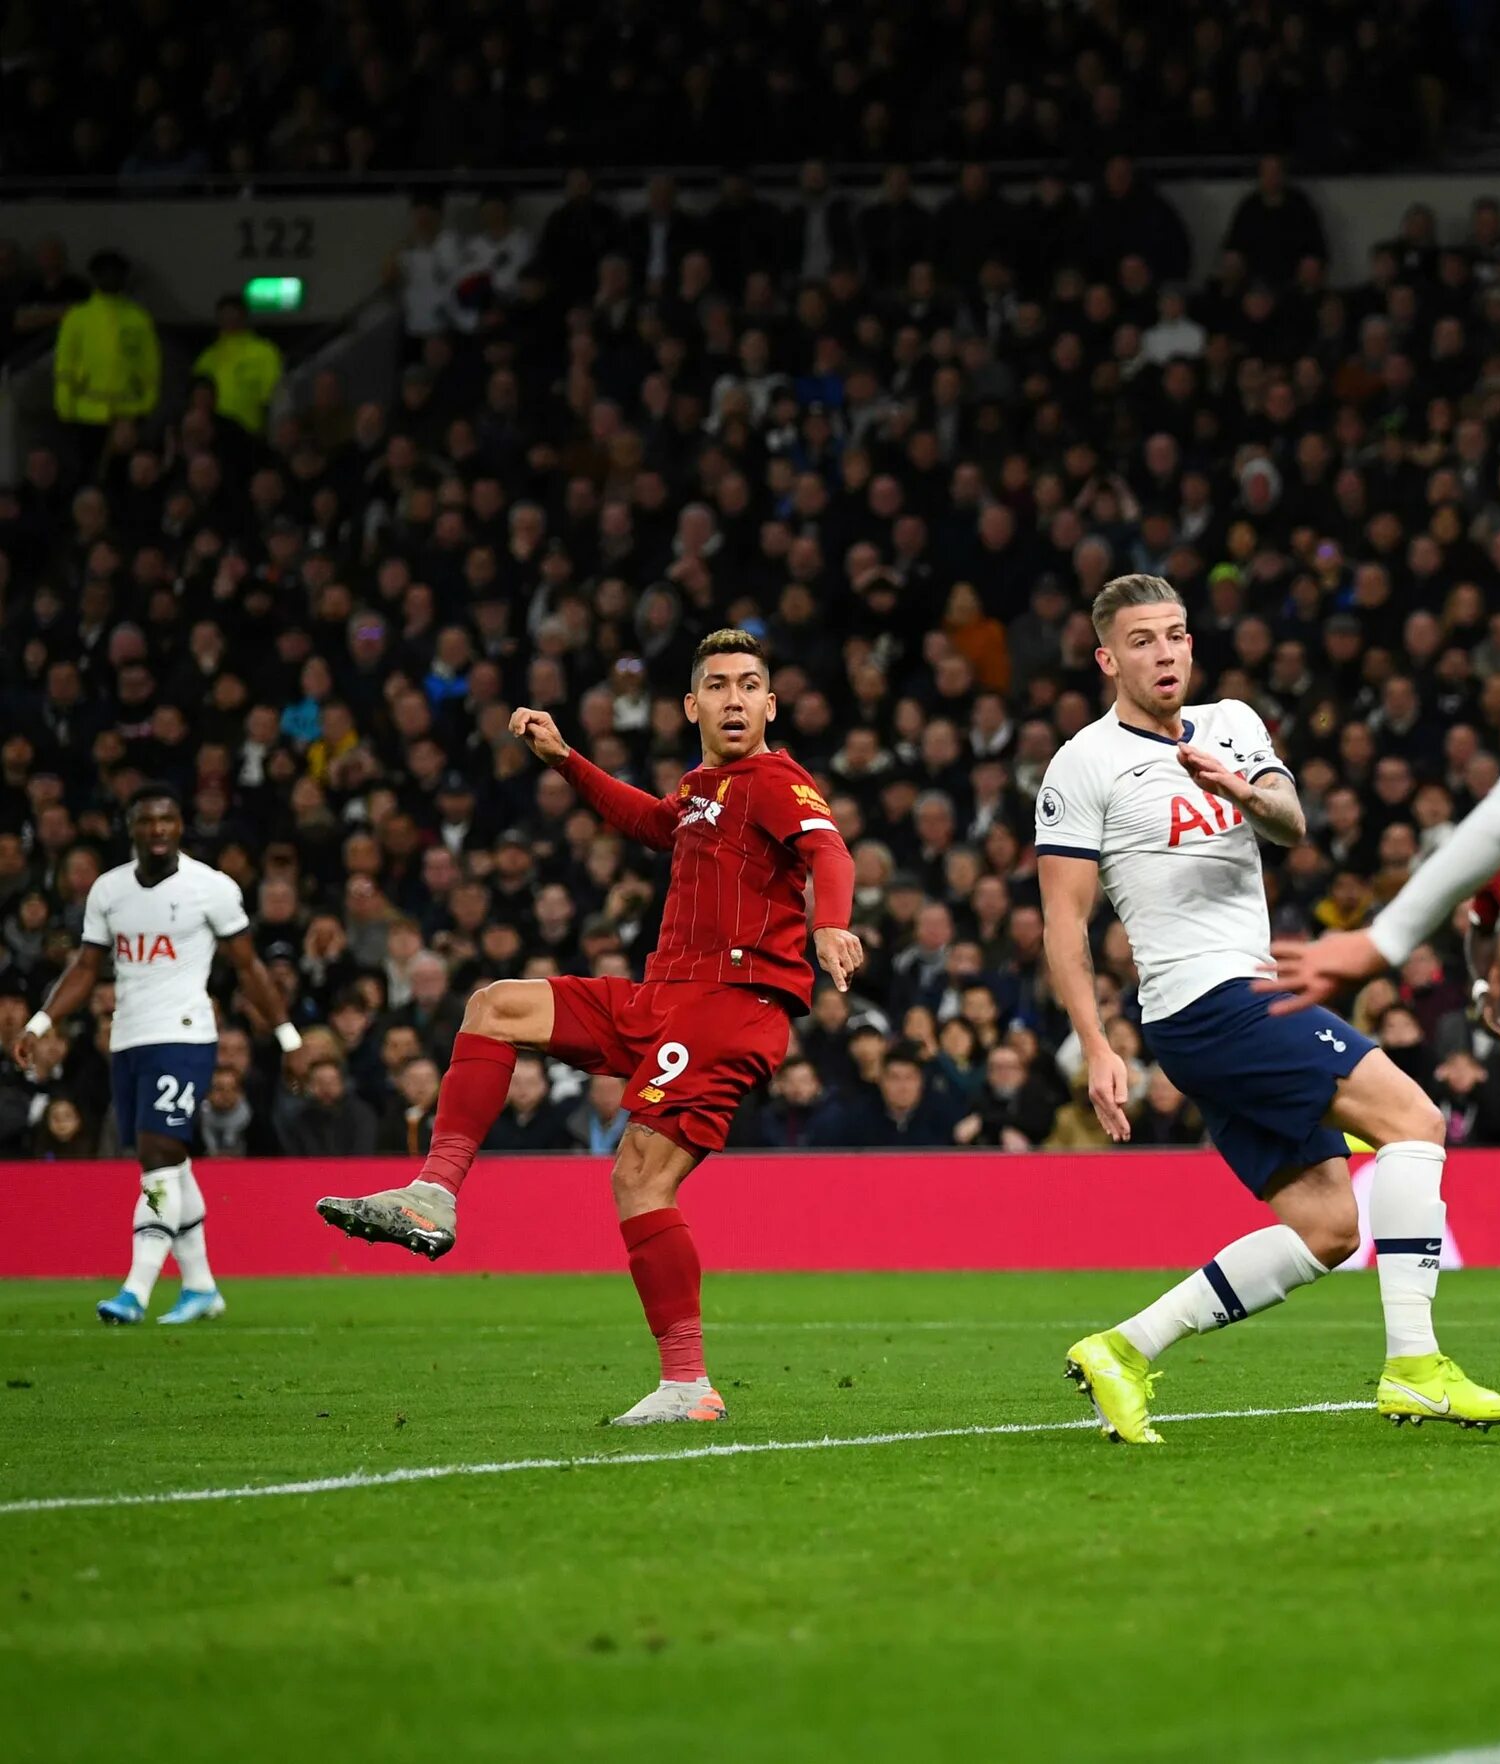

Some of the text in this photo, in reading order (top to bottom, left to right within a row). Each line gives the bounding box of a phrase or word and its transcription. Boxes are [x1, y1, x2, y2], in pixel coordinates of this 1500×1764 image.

[235, 216, 315, 260] 122
[116, 932, 177, 963] AIA
[649, 1041, 689, 1086] 9
[153, 1074, 195, 1118] 24
